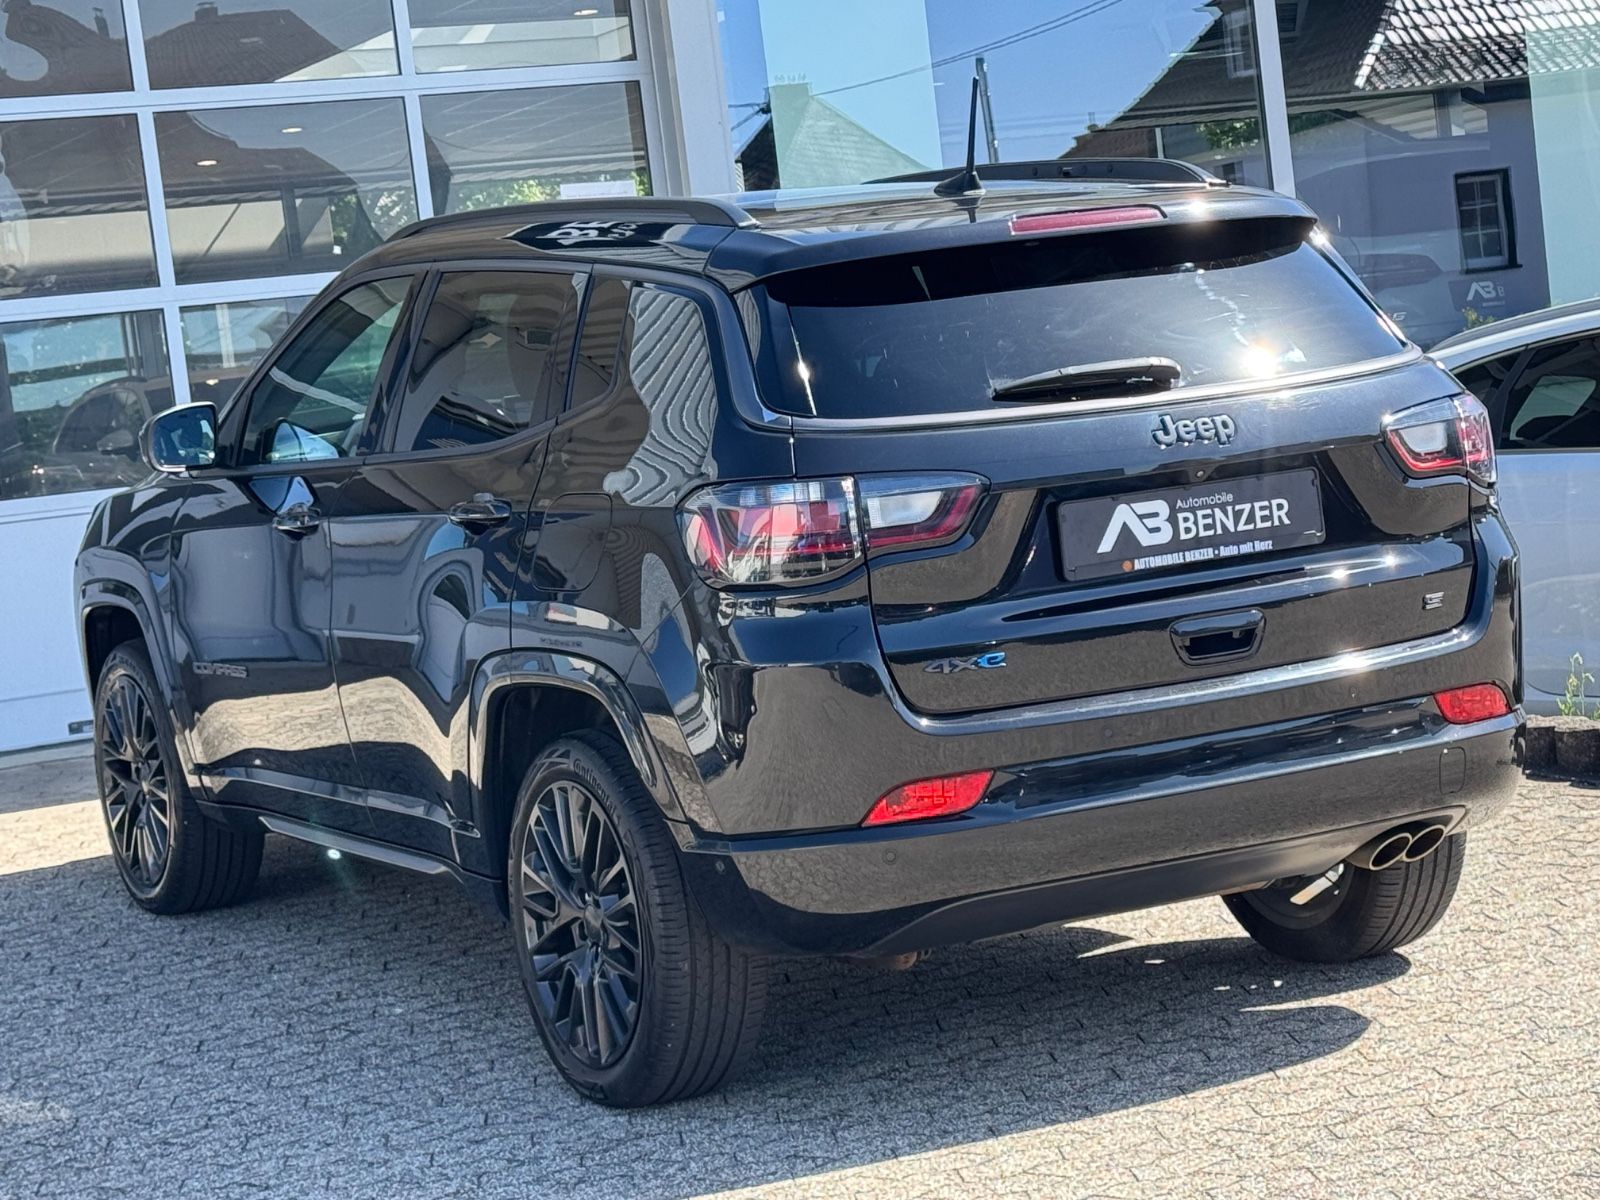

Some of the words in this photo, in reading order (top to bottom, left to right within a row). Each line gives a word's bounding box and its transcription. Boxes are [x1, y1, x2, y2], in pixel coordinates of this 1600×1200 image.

[1151, 413, 1237, 448] Jeep
[1175, 491, 1234, 510] Automobile
[1176, 498, 1291, 541] BENZER
[1134, 551, 1184, 571] AUTOMOBILE
[1184, 547, 1214, 562] BENZER
[1219, 544, 1239, 557] Auto
